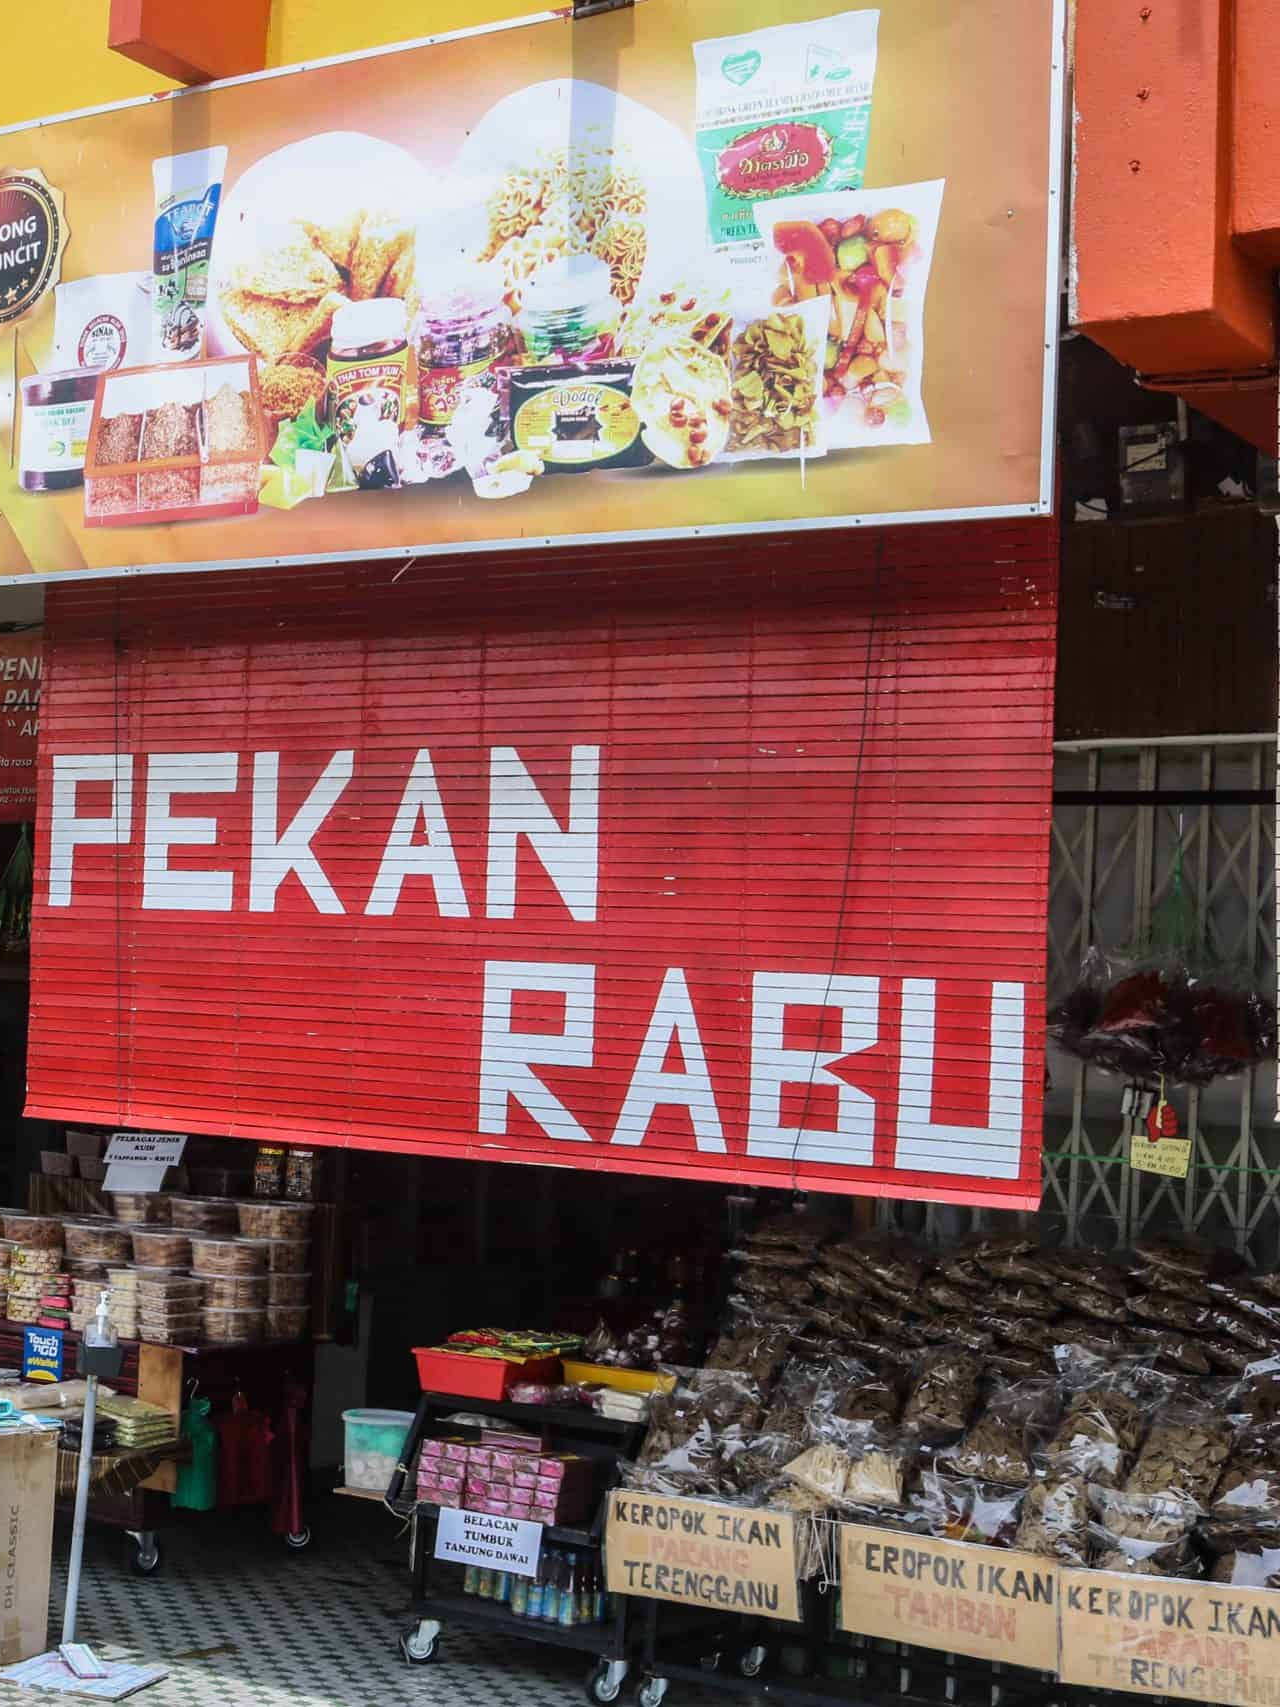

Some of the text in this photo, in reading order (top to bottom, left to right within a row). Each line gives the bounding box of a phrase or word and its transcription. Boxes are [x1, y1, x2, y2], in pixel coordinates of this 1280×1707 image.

[47, 745, 600, 922] PEKAN
[478, 960, 1025, 1180] RABU
[27, 1332, 59, 1347] Touch
[7, 1504, 21, 1577] CLASSIC
[464, 1514, 519, 1532] BELACAN
[464, 1530, 513, 1548] TUMBUK
[615, 1500, 782, 1549] KEROPOK IKAN
[445, 1541, 529, 1565] TANJUNG DAWAI
[623, 1559, 780, 1611] TERENGGANU
[976, 1563, 1054, 1605] IKAN
[1067, 1584, 1194, 1630] KEROPOK
[883, 1583, 1017, 1643] TAMBAN
